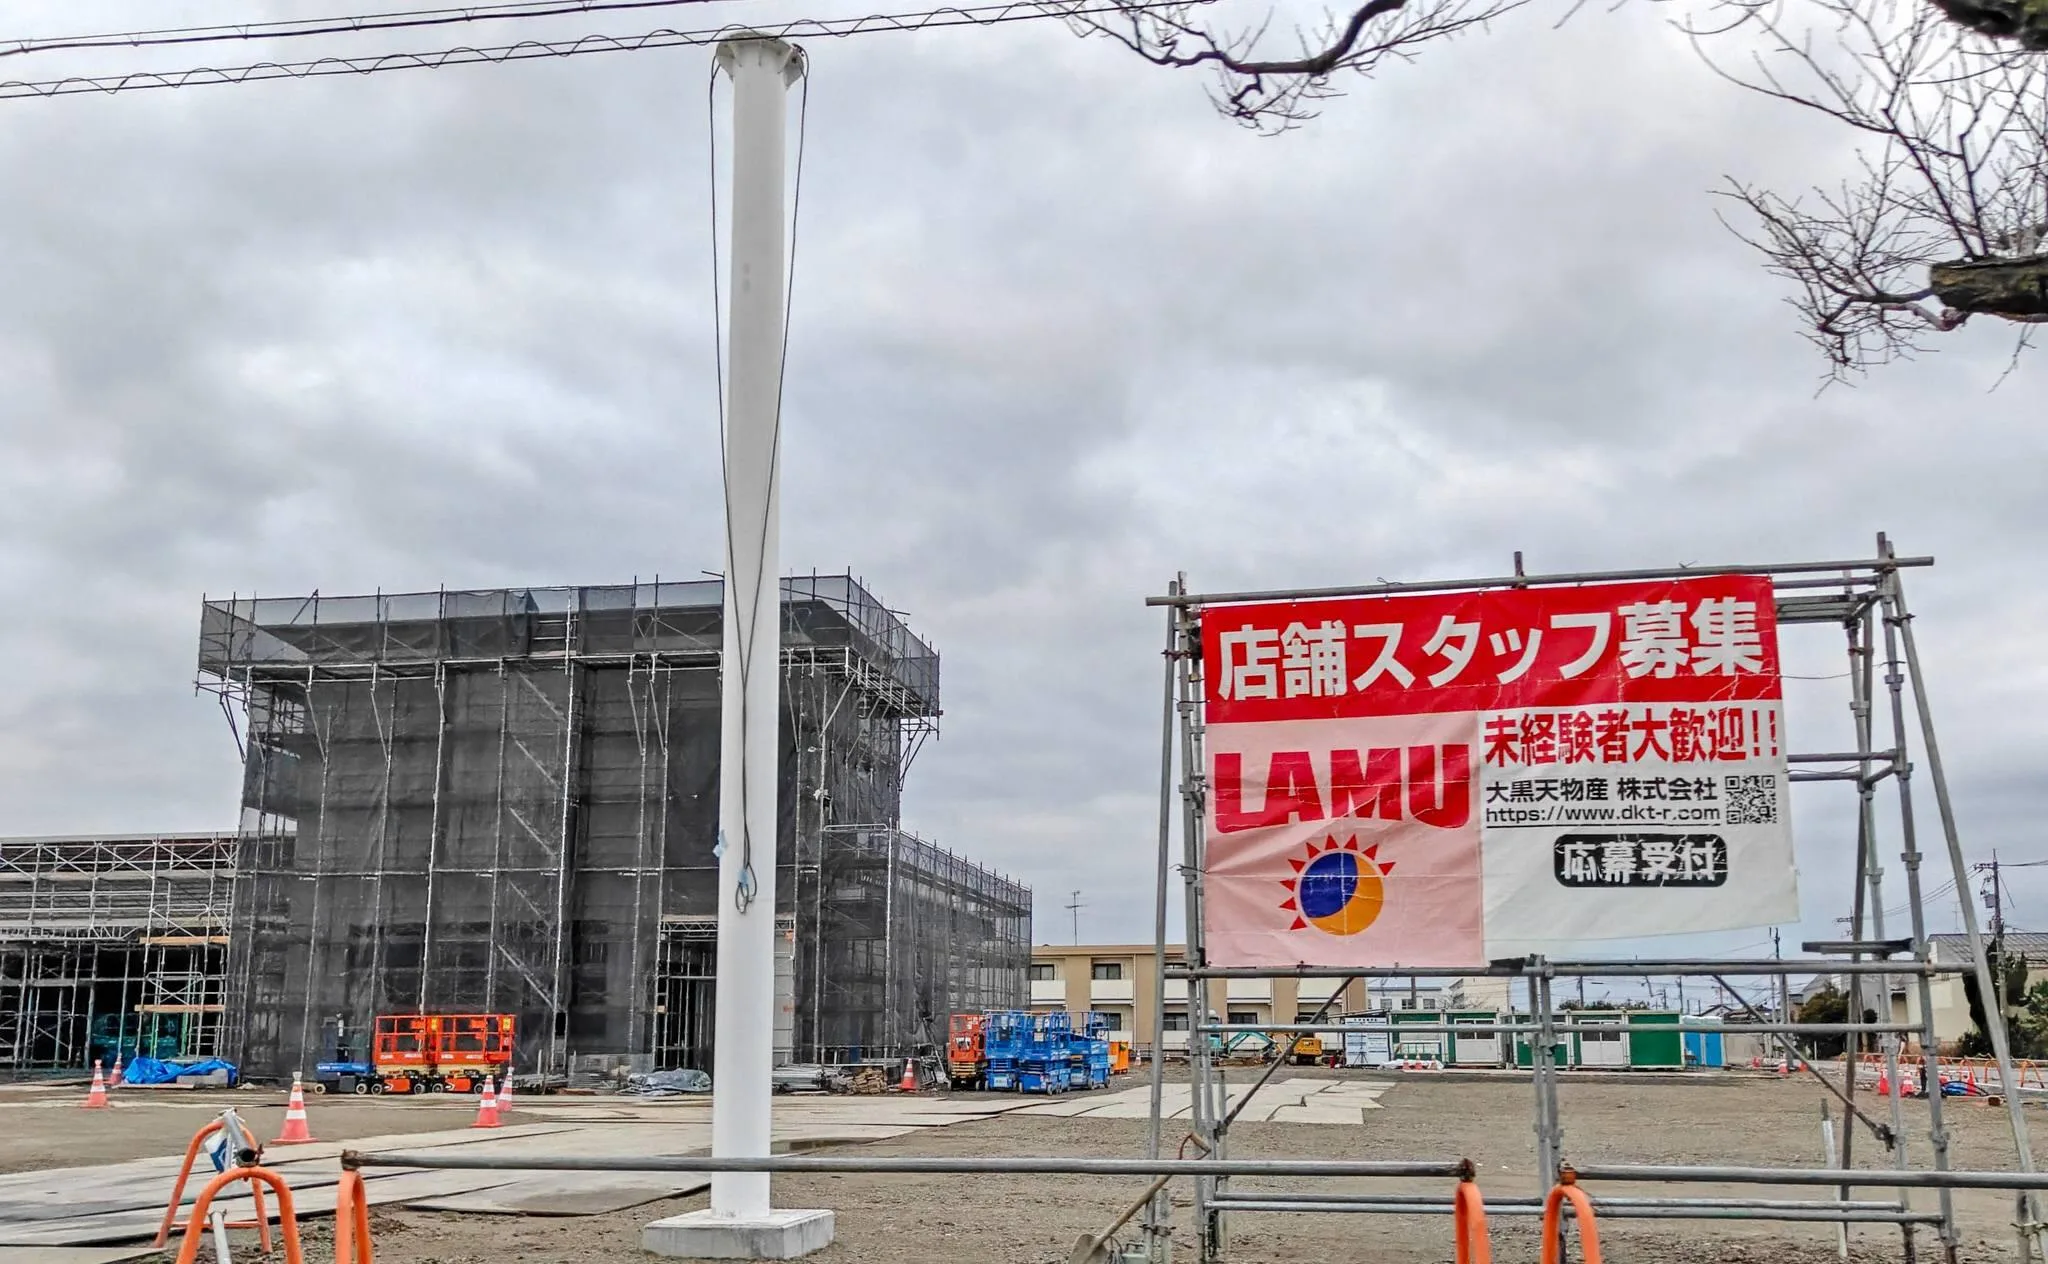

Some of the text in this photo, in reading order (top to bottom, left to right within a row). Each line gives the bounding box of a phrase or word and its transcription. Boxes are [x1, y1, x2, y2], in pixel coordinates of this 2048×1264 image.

[1218, 596, 1764, 701] 店舗スタッフ募集
[1484, 707, 1778, 768] 未経験者大歓迎!!
[1214, 744, 1470, 834] LAMU
[1486, 776, 1718, 804] 大黒天物産 株式会社
[1486, 804, 1721, 824] https://www.dkt-r.com
